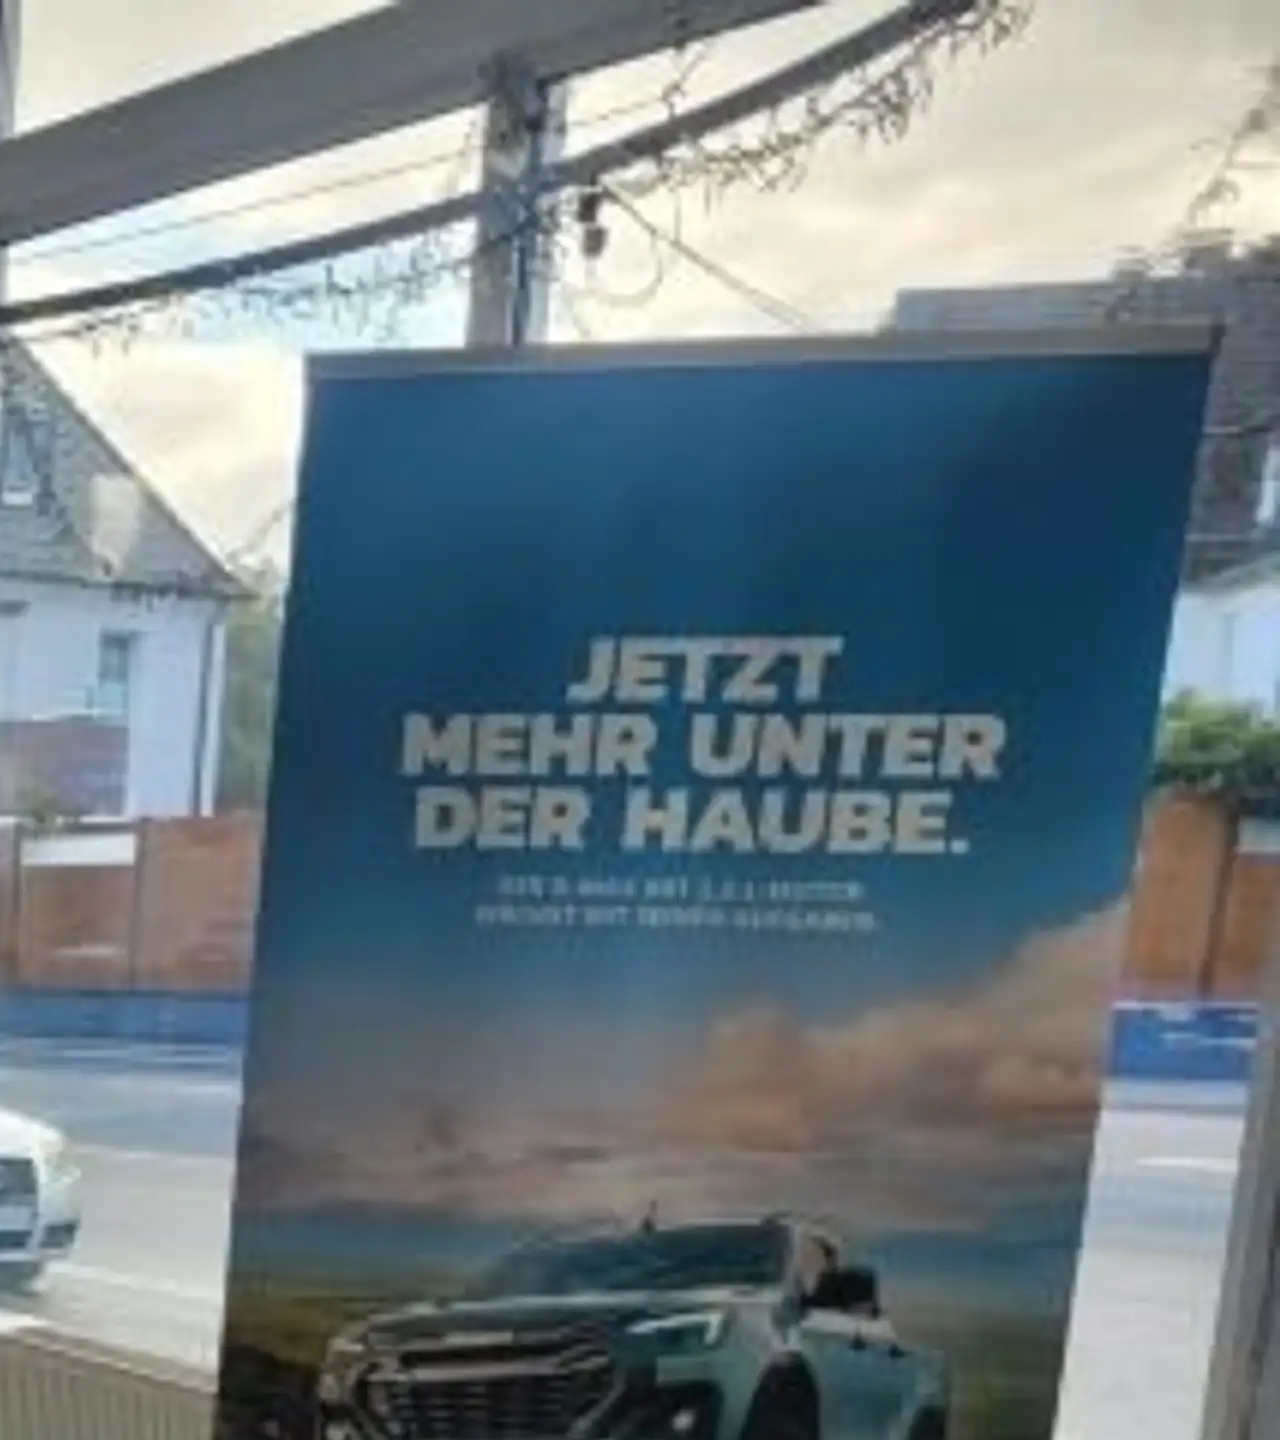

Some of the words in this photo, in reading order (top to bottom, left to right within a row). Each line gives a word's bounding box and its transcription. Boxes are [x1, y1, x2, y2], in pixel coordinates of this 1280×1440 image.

[566, 635, 844, 703] JETZT
[397, 711, 658, 777] MEHR
[688, 712, 1007, 779] UNTER
[414, 786, 589, 850] DER
[619, 787, 970, 855] HAUBE.
